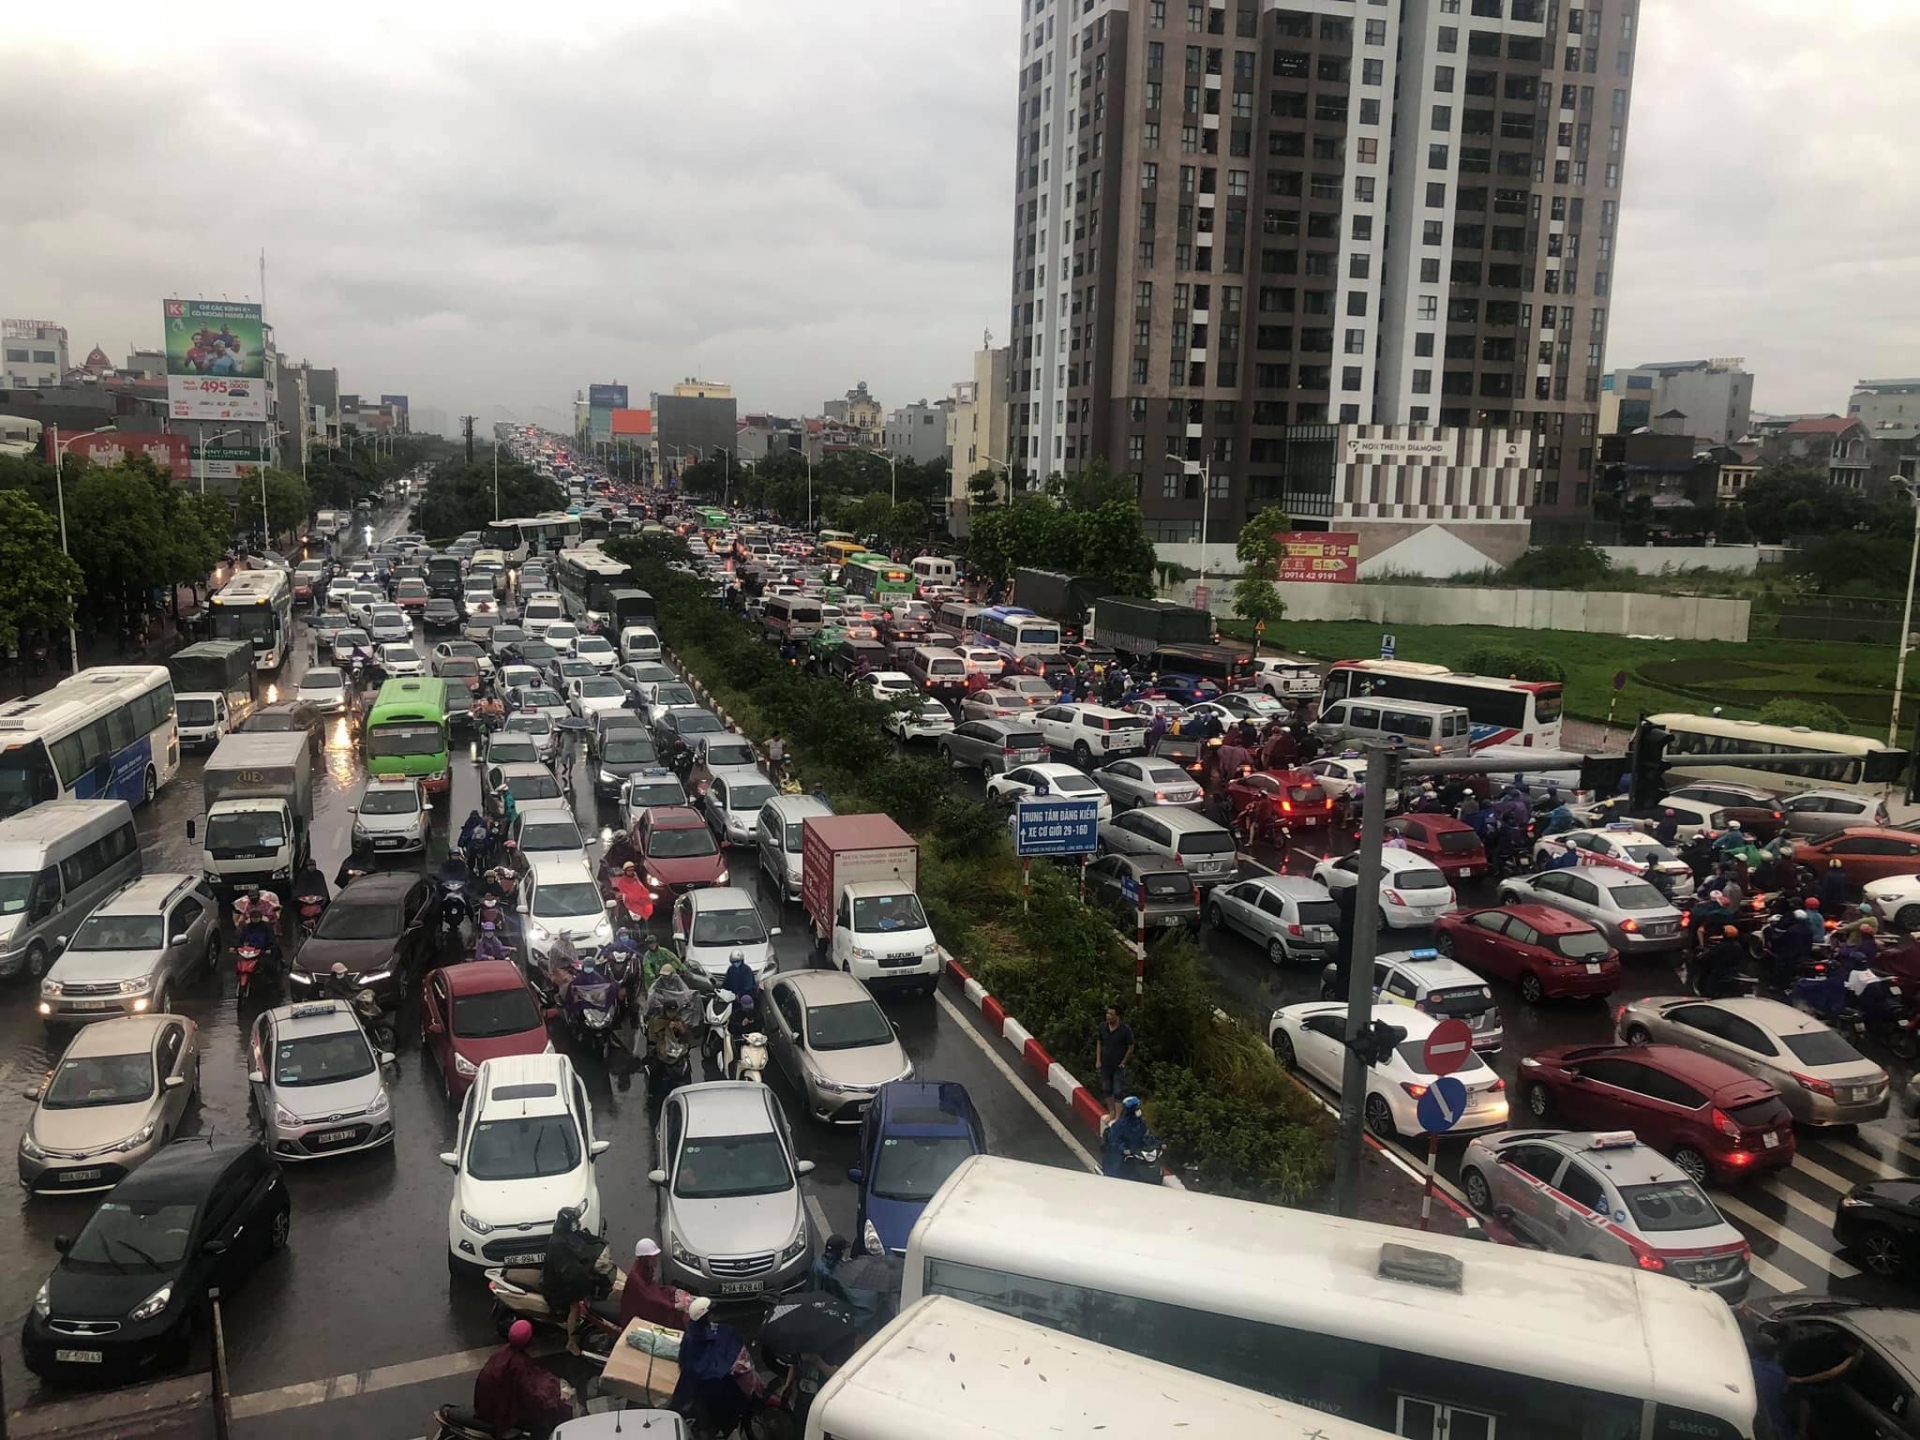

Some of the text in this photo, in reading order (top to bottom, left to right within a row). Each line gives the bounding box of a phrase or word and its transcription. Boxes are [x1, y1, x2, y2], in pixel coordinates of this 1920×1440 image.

[1362, 443, 1443, 452] NORTHERN DIAMOND
[1318, 572, 1337, 580] 9191
[1021, 811, 1043, 823] TRUNG
[1045, 808, 1059, 822] TÂM
[1028, 826, 1037, 838] XE
[1038, 825, 1048, 837] CƠ
[886, 951, 915, 959] SUZUKI
[1668, 1420, 1719, 1437] SAMCO
